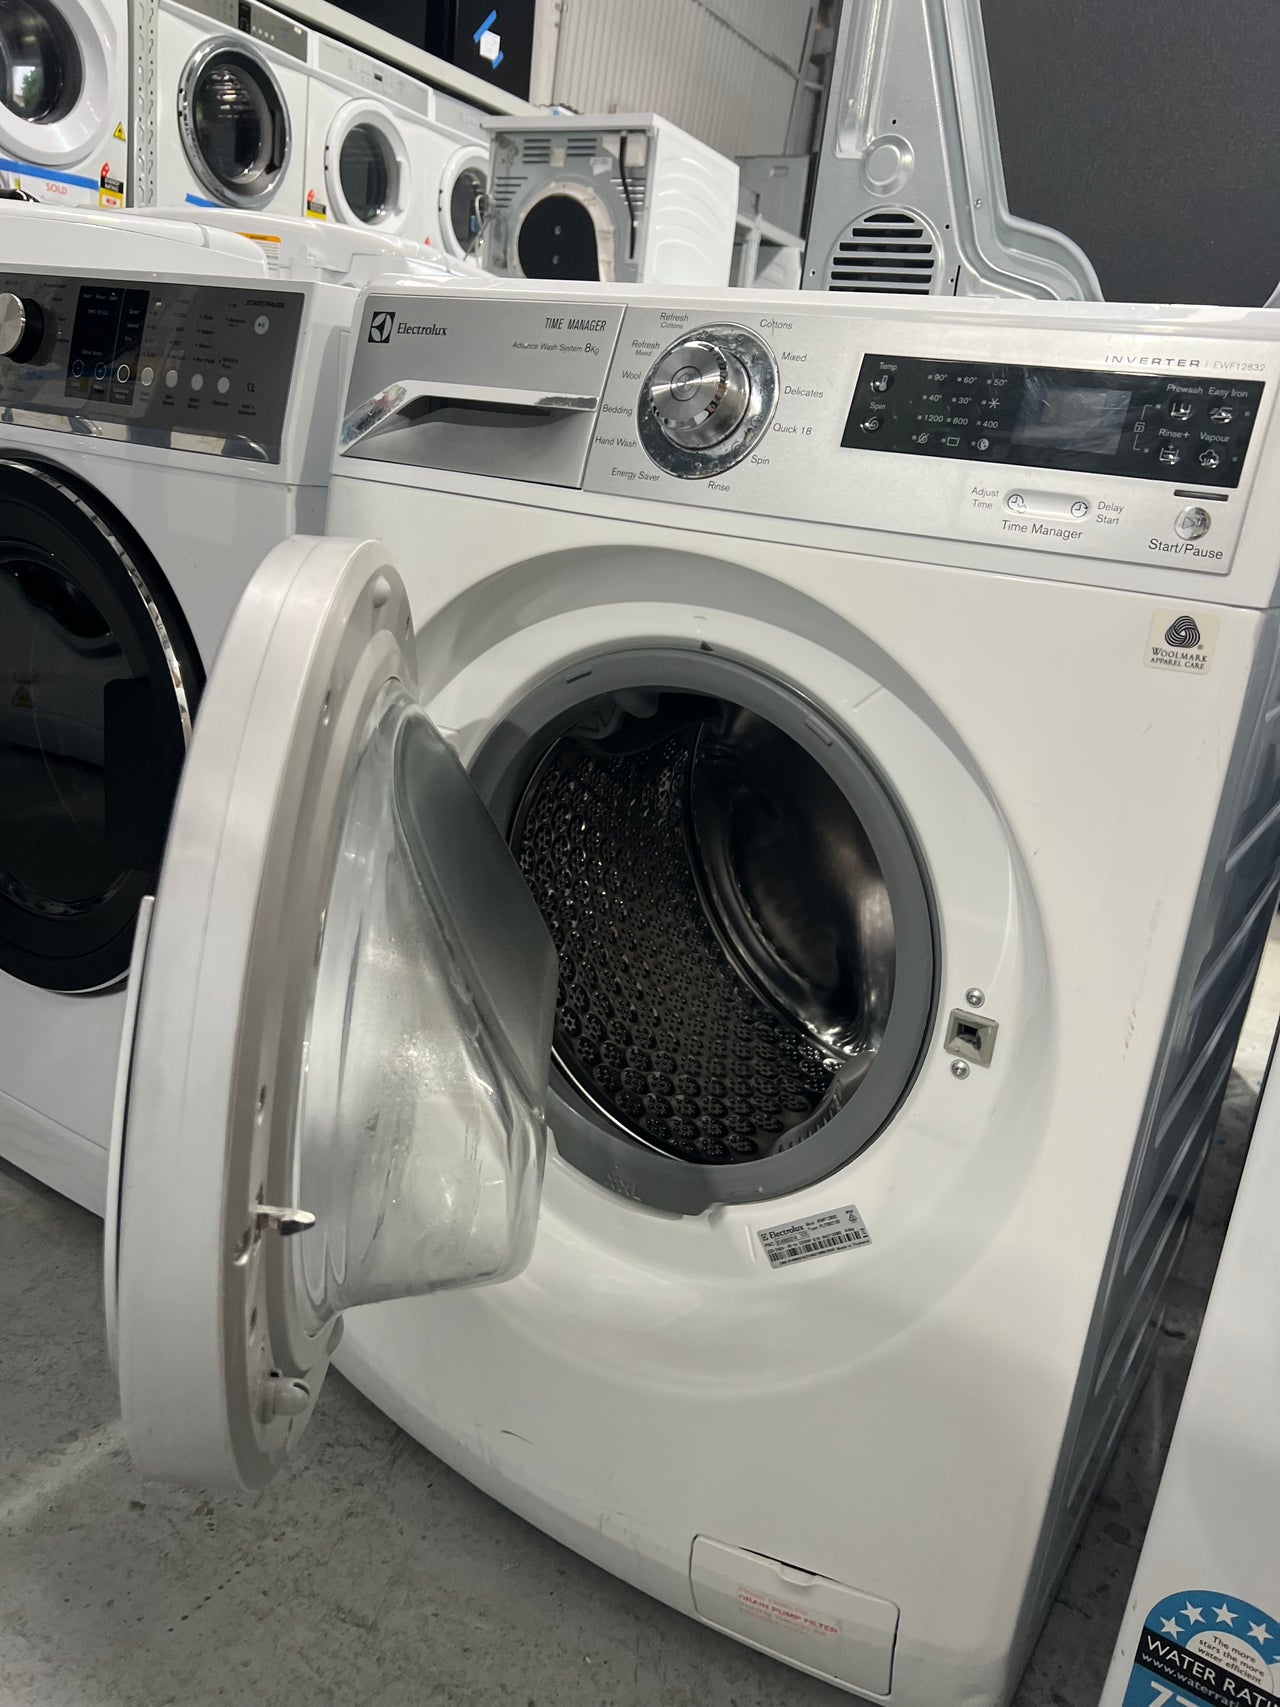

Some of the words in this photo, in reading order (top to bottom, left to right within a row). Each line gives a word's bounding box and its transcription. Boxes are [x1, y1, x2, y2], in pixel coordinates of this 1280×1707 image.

[45, 182, 68, 196] SOLD
[660, 312, 689, 322] Refresh
[397, 322, 448, 336] Electrolux
[545, 317, 564, 330] TIME
[568, 318, 607, 332] MANAGER
[660, 322, 684, 330] Cottons
[760, 318, 793, 330] Cottons
[512, 341, 539, 351] Advance
[540, 342, 558, 352] Wash
[559, 344, 582, 354] System
[632, 340, 660, 350] Refresh
[635, 349, 652, 357] Mixed
[782, 352, 806, 362] Mixed
[879, 362, 898, 372] Temp
[1104, 354, 1201, 368] INVERTER
[1212, 360, 1266, 372] EWF12832
[622, 370, 642, 380] Wool
[784, 386, 824, 398] Delicates
[1166, 382, 1204, 395] Prewash
[1208, 386, 1229, 398] Easy
[1230, 388, 1248, 398] Iron
[602, 404, 633, 416] Bedding
[870, 401, 886, 412] Spin
[924, 414, 944, 424] 1200
[952, 416, 968, 426] 800
[982, 420, 999, 430] 400
[773, 422, 798, 434] Quick
[801, 425, 812, 436] 18
[1158, 427, 1190, 440] Rinse+
[596, 436, 616, 446] Hand
[618, 438, 638, 448] Wash
[1200, 432, 1230, 444] Vapour
[750, 454, 770, 466] Spin
[612, 468, 638, 480] Energy
[638, 472, 660, 482] Saver
[708, 481, 730, 492] Rinse
[972, 486, 1000, 499] Adjust
[972, 499, 993, 510] Time
[1098, 501, 1124, 514] Delay
[1096, 514, 1120, 526] Start
[1001, 520, 1028, 534] Time
[1031, 522, 1083, 540] Manager
[1148, 538, 1224, 560] Start/Pause
[1152, 646, 1208, 662] WOOLMARK
[1150, 657, 1182, 667] APPAREL
[1184, 662, 1204, 670] CARE
[768, 1225, 804, 1239] Electrolux
[738, 1594, 769, 1610] DRAIN
[771, 1606, 802, 1621] PUMP
[804, 1618, 838, 1634] FILTER
[1212, 1635, 1229, 1650] The
[1232, 1645, 1256, 1664] more
[1147, 1636, 1216, 1686] WATER
[1199, 1638, 1220, 1654] stars
[1223, 1648, 1238, 1662] the
[1240, 1660, 1265, 1678] more
[1198, 1648, 1224, 1664] water
[1225, 1662, 1262, 1685] efficient
